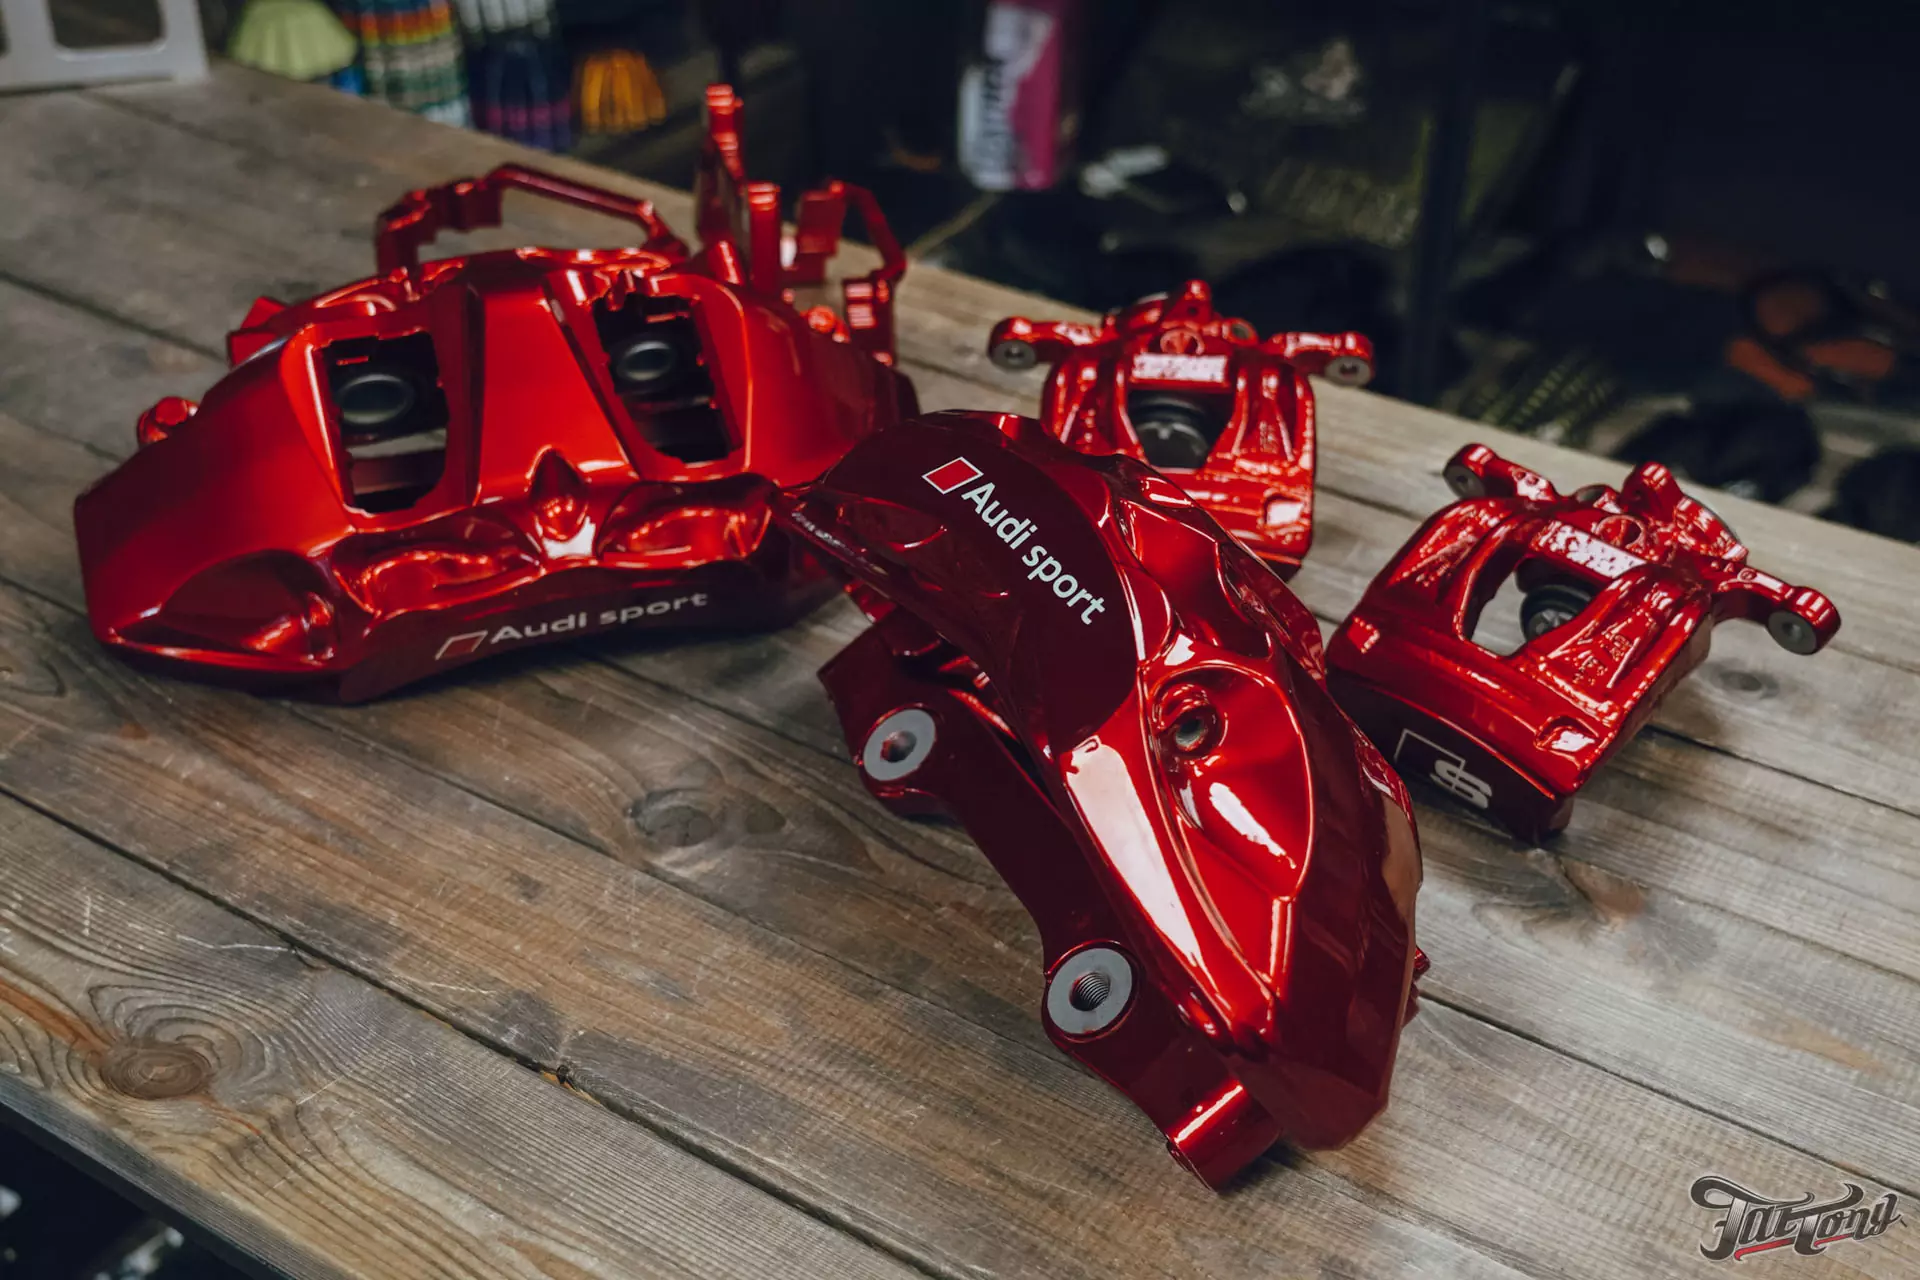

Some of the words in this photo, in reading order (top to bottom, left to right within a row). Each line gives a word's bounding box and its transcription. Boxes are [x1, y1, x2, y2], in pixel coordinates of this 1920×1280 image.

[961, 482, 1038, 550] Audi
[1021, 545, 1106, 625] sport
[490, 612, 587, 643] Audi
[600, 593, 708, 623] sport
